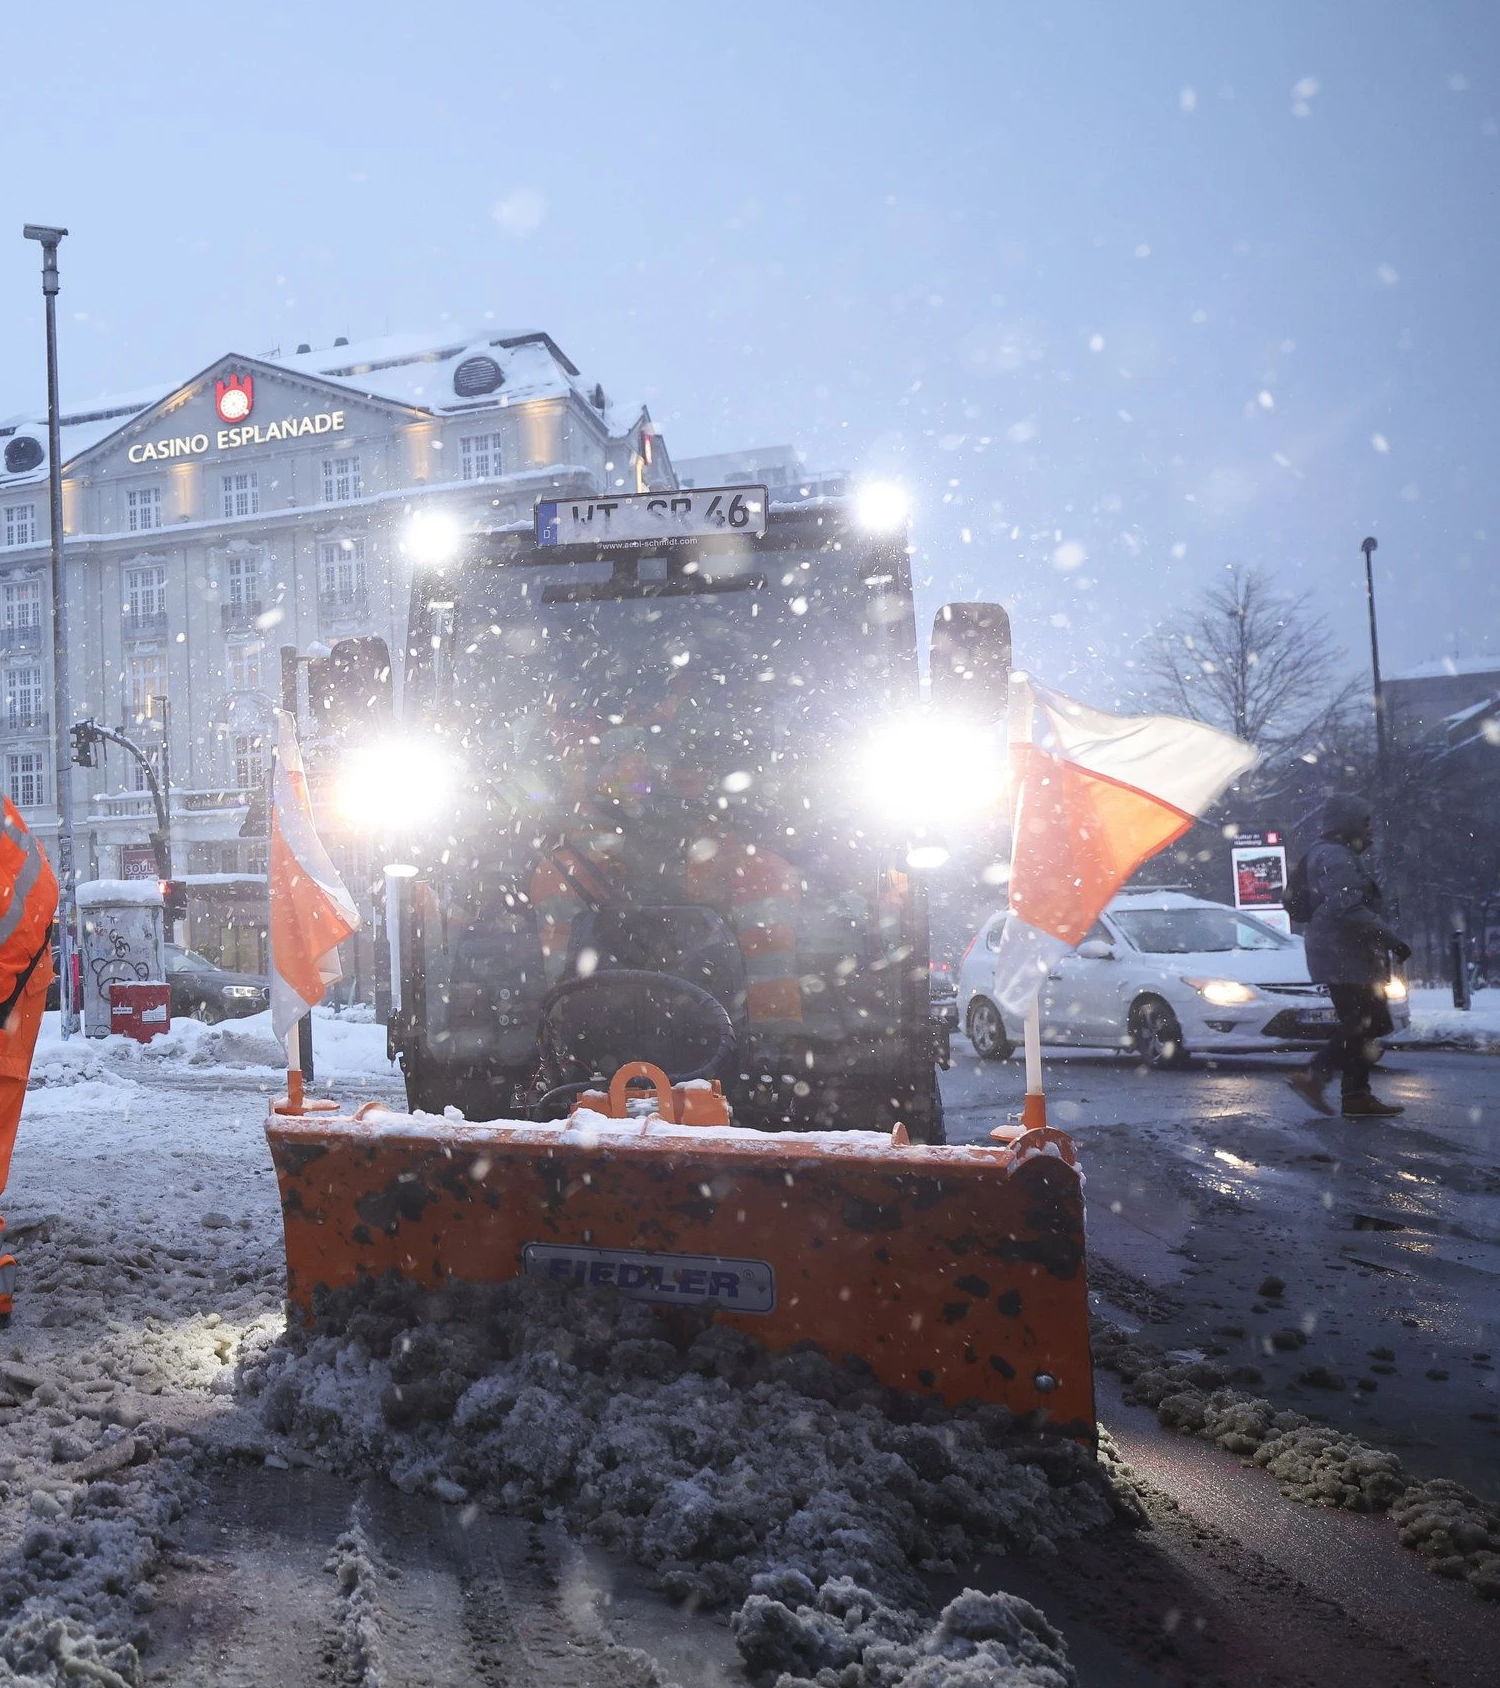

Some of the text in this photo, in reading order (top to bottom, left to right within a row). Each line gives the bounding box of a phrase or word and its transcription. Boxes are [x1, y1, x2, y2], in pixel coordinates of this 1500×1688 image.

[128, 410, 345, 464] CASINO ESPLANADE
[704, 494, 750, 529] 46
[125, 863, 154, 875] SOUL
[550, 1258, 741, 1299] FIEDLER
